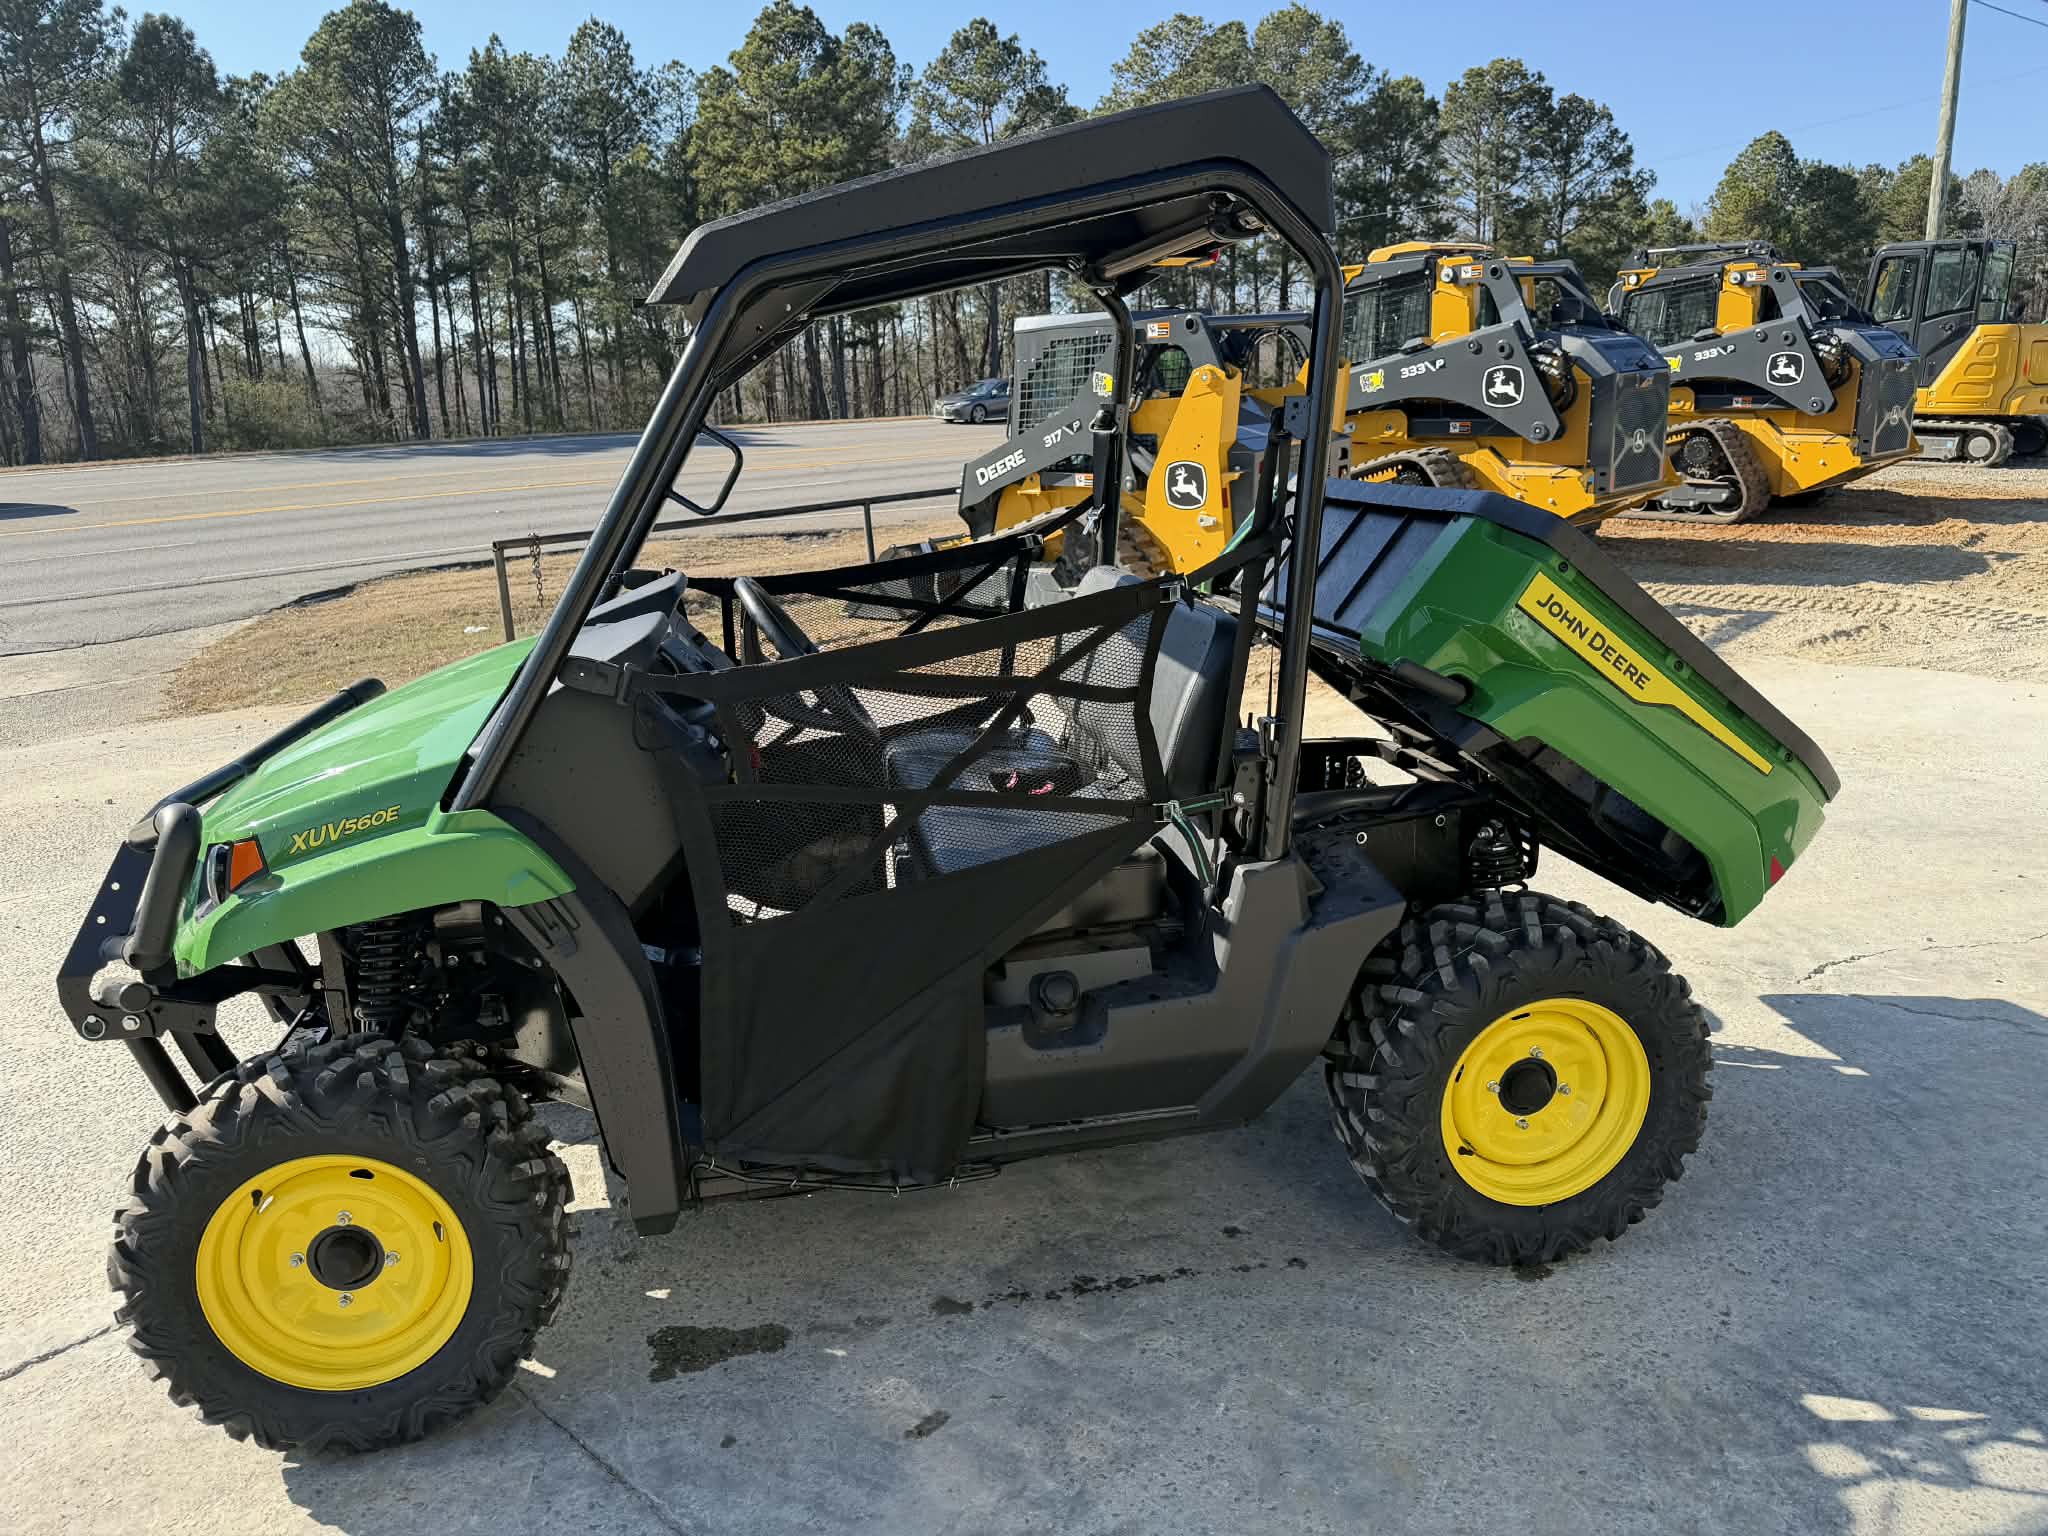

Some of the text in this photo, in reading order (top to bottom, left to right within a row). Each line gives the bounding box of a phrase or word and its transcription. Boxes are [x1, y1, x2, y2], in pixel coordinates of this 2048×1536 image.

[975, 449, 1026, 486] DEERE
[1536, 593, 1650, 691] JOHN DEERE
[288, 804, 400, 855] XUV560E
